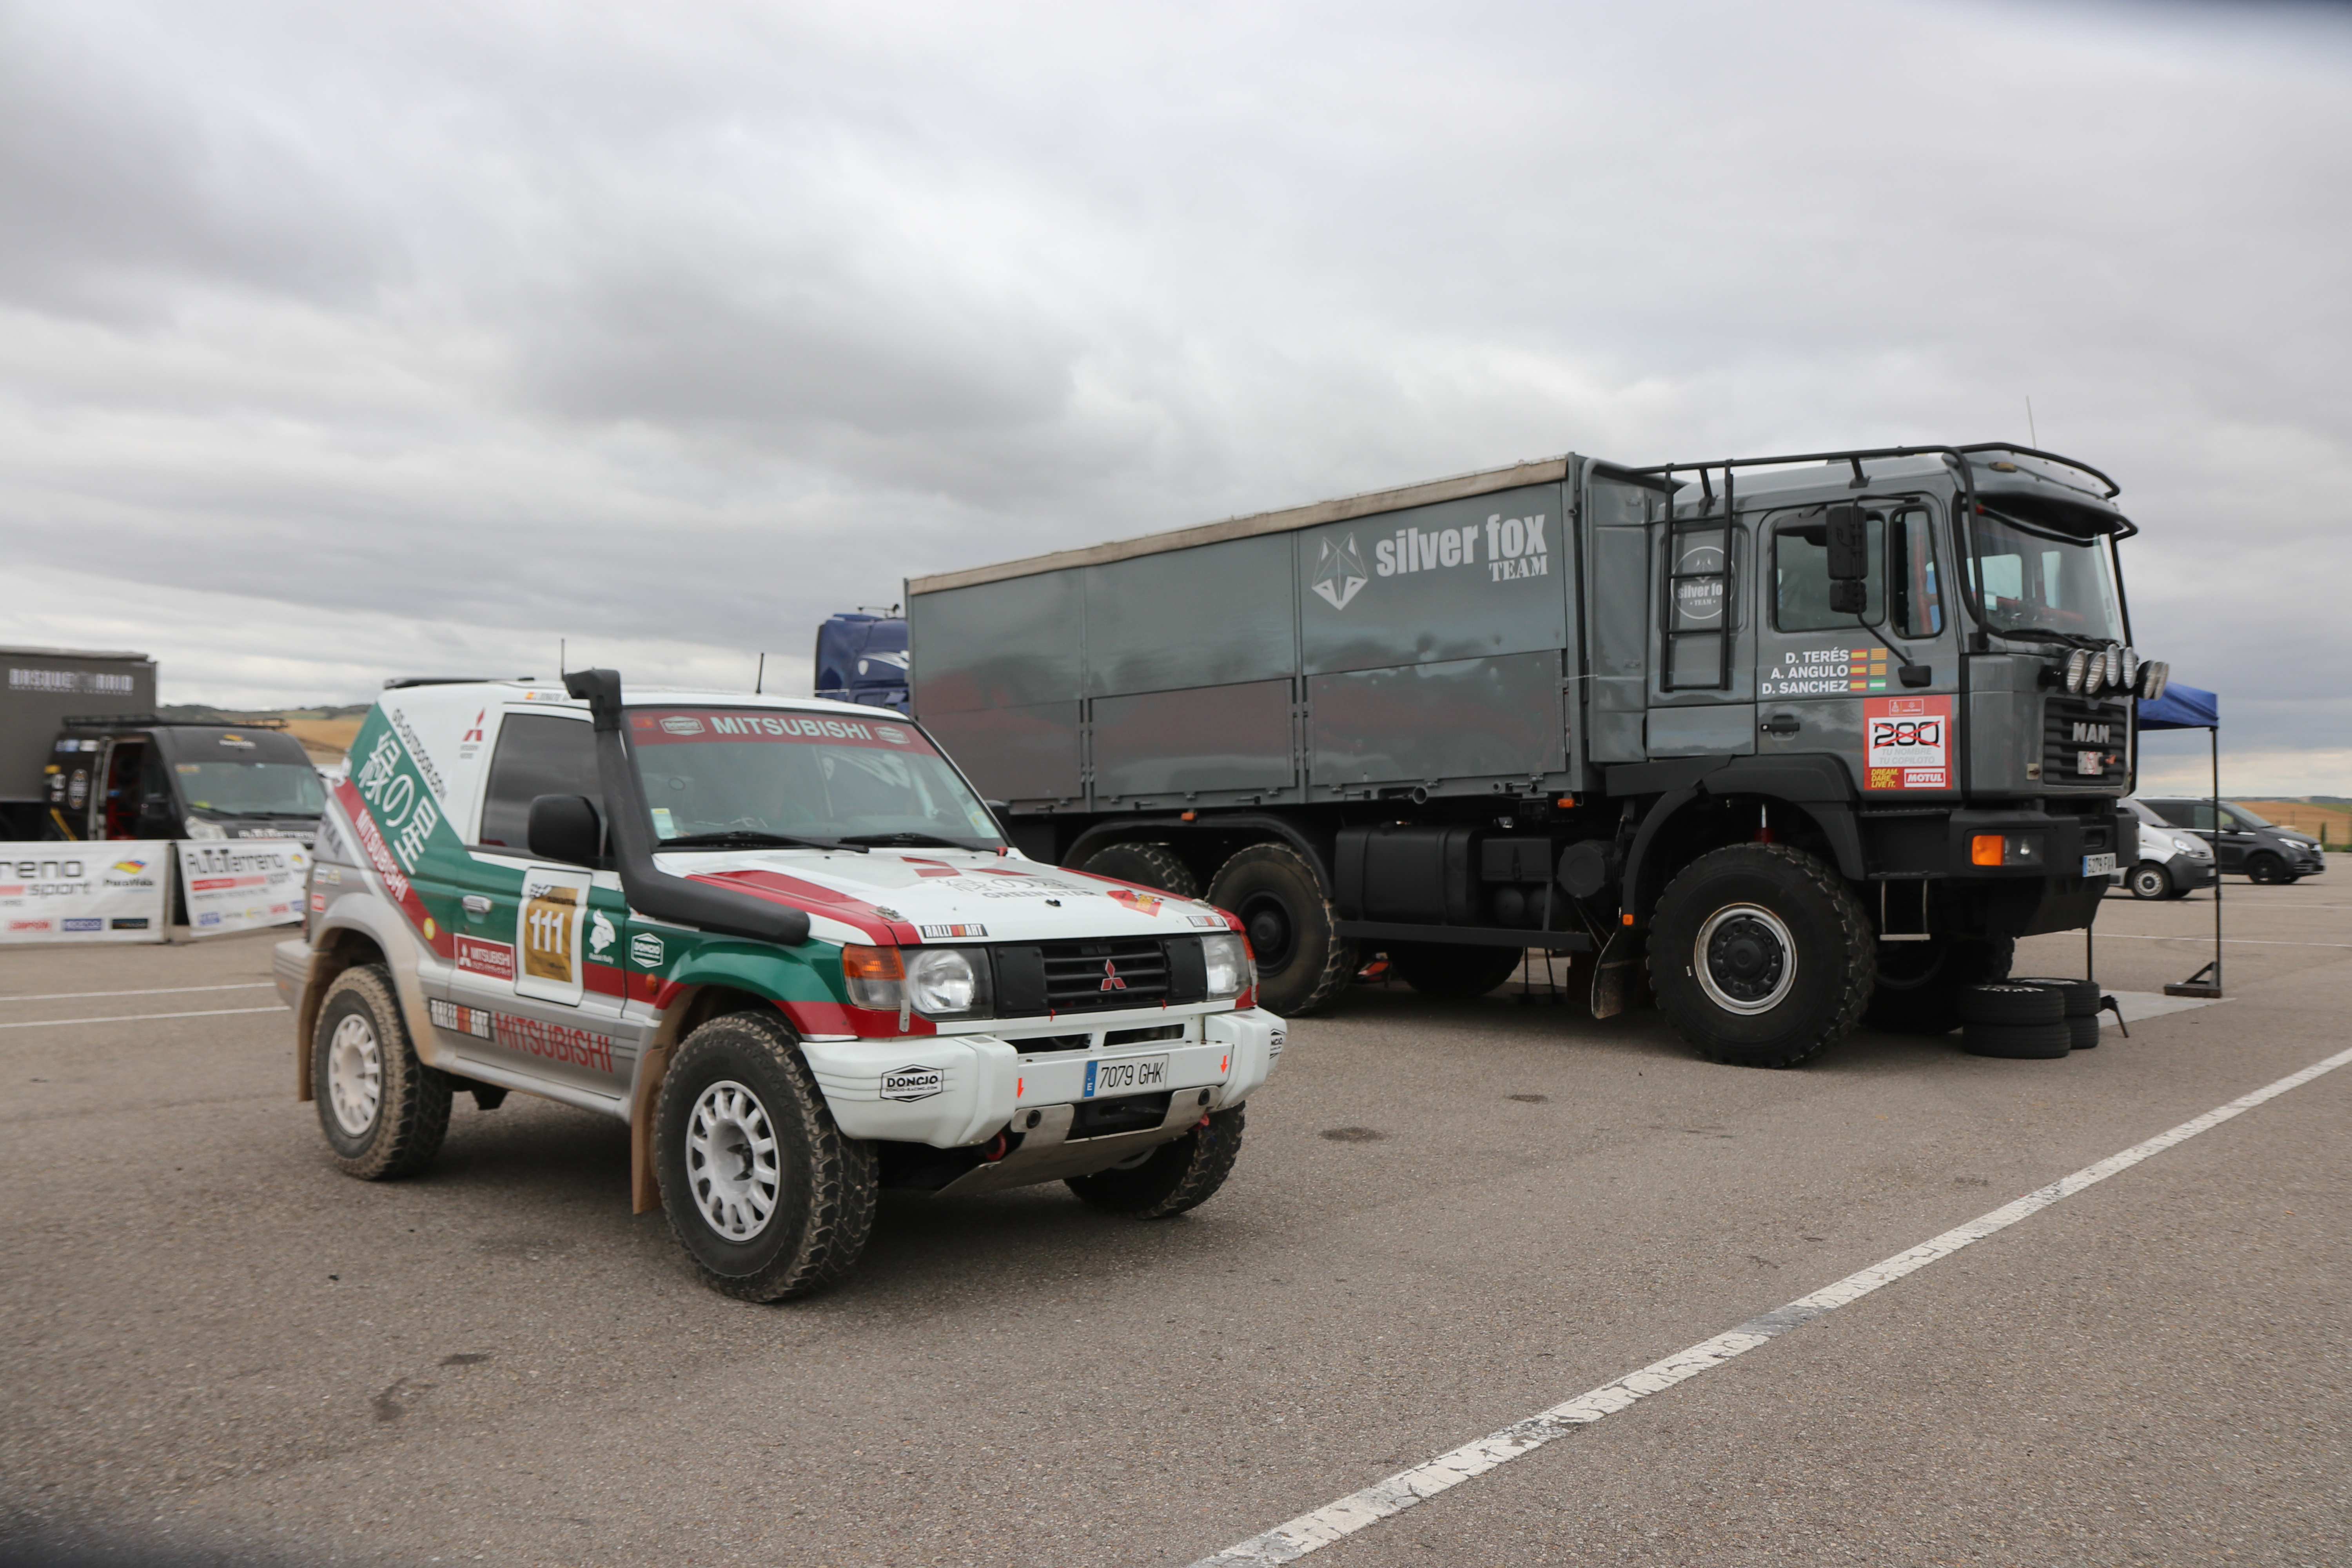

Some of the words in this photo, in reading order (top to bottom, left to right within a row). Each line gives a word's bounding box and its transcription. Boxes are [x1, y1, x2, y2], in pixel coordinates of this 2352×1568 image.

[1375, 526, 1479, 577] silver
[1486, 514, 1547, 561] fox
[1489, 555, 1548, 582] TEAM
[1678, 584, 1710, 599] silver
[1711, 583, 1723, 596] fo
[1785, 652, 1799, 664] D.
[1803, 646, 1849, 663] TERÉS
[1770, 667, 1784, 679] A.
[1788, 664, 1848, 679] ANGULO
[1762, 682, 1776, 695] D.
[1779, 680, 1848, 694] SANCHEZ
[710, 717, 873, 740] MITSUBISHI
[1875, 721, 1939, 746] 200
[2073, 722, 2110, 744] MAN
[1892, 756, 1935, 764] COPILOTO
[1895, 748, 1932, 756] NOMBRE
[1907, 773, 1943, 782] MOTUL
[358, 730, 439, 875] 緑の星
[356, 808, 409, 902] MITSUBISHI
[29, 881, 92, 898] sport
[530, 908, 565, 955] 111
[924, 925, 953, 937] RALLI
[965, 924, 984, 936] ART
[470, 946, 511, 967] MITSUBISHI
[588, 952, 603, 962] Rabbit
[603, 954, 614, 965] Rally
[430, 998, 458, 1031] RALLI
[470, 1009, 490, 1039] ART
[495, 1011, 613, 1073] MITSUBISHI
[1087, 1082, 1093, 1091] E
[1099, 1064, 1134, 1089] 7079
[1138, 1062, 1164, 1085] GHK
